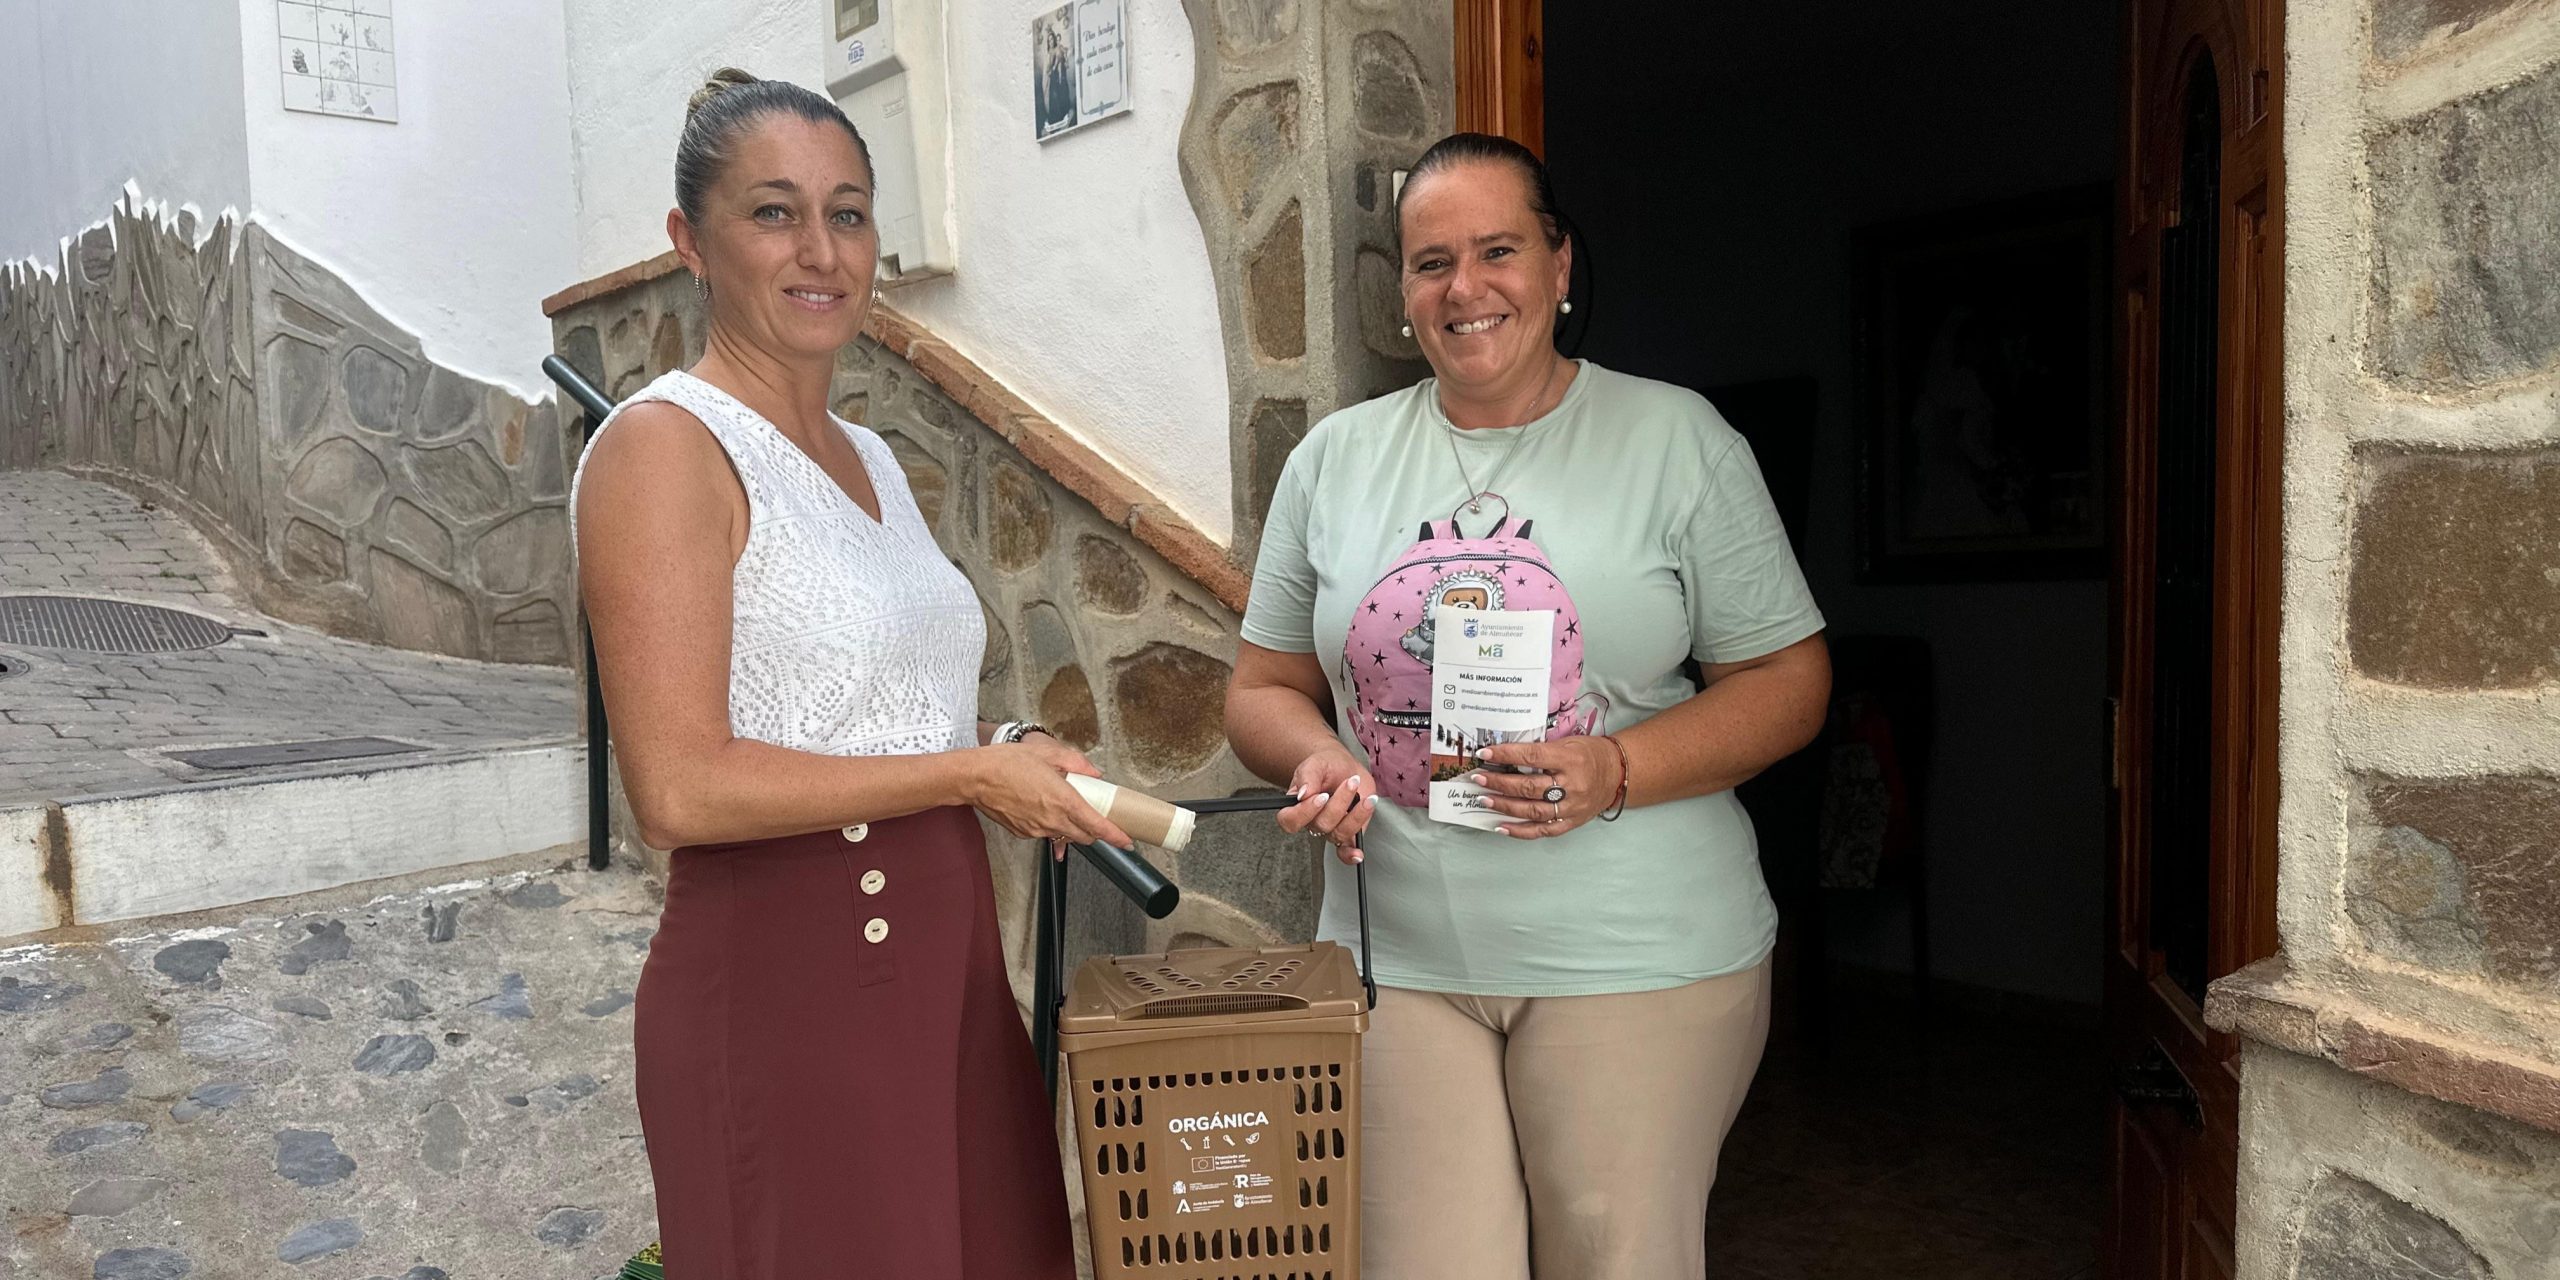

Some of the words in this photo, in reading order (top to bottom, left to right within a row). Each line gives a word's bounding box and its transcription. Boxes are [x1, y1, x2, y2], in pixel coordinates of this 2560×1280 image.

[1476, 674, 1522, 683] INFORMACIÓN
[1448, 789, 1460, 799] Un
[1168, 1110, 1270, 1133] ORGÁNICA
